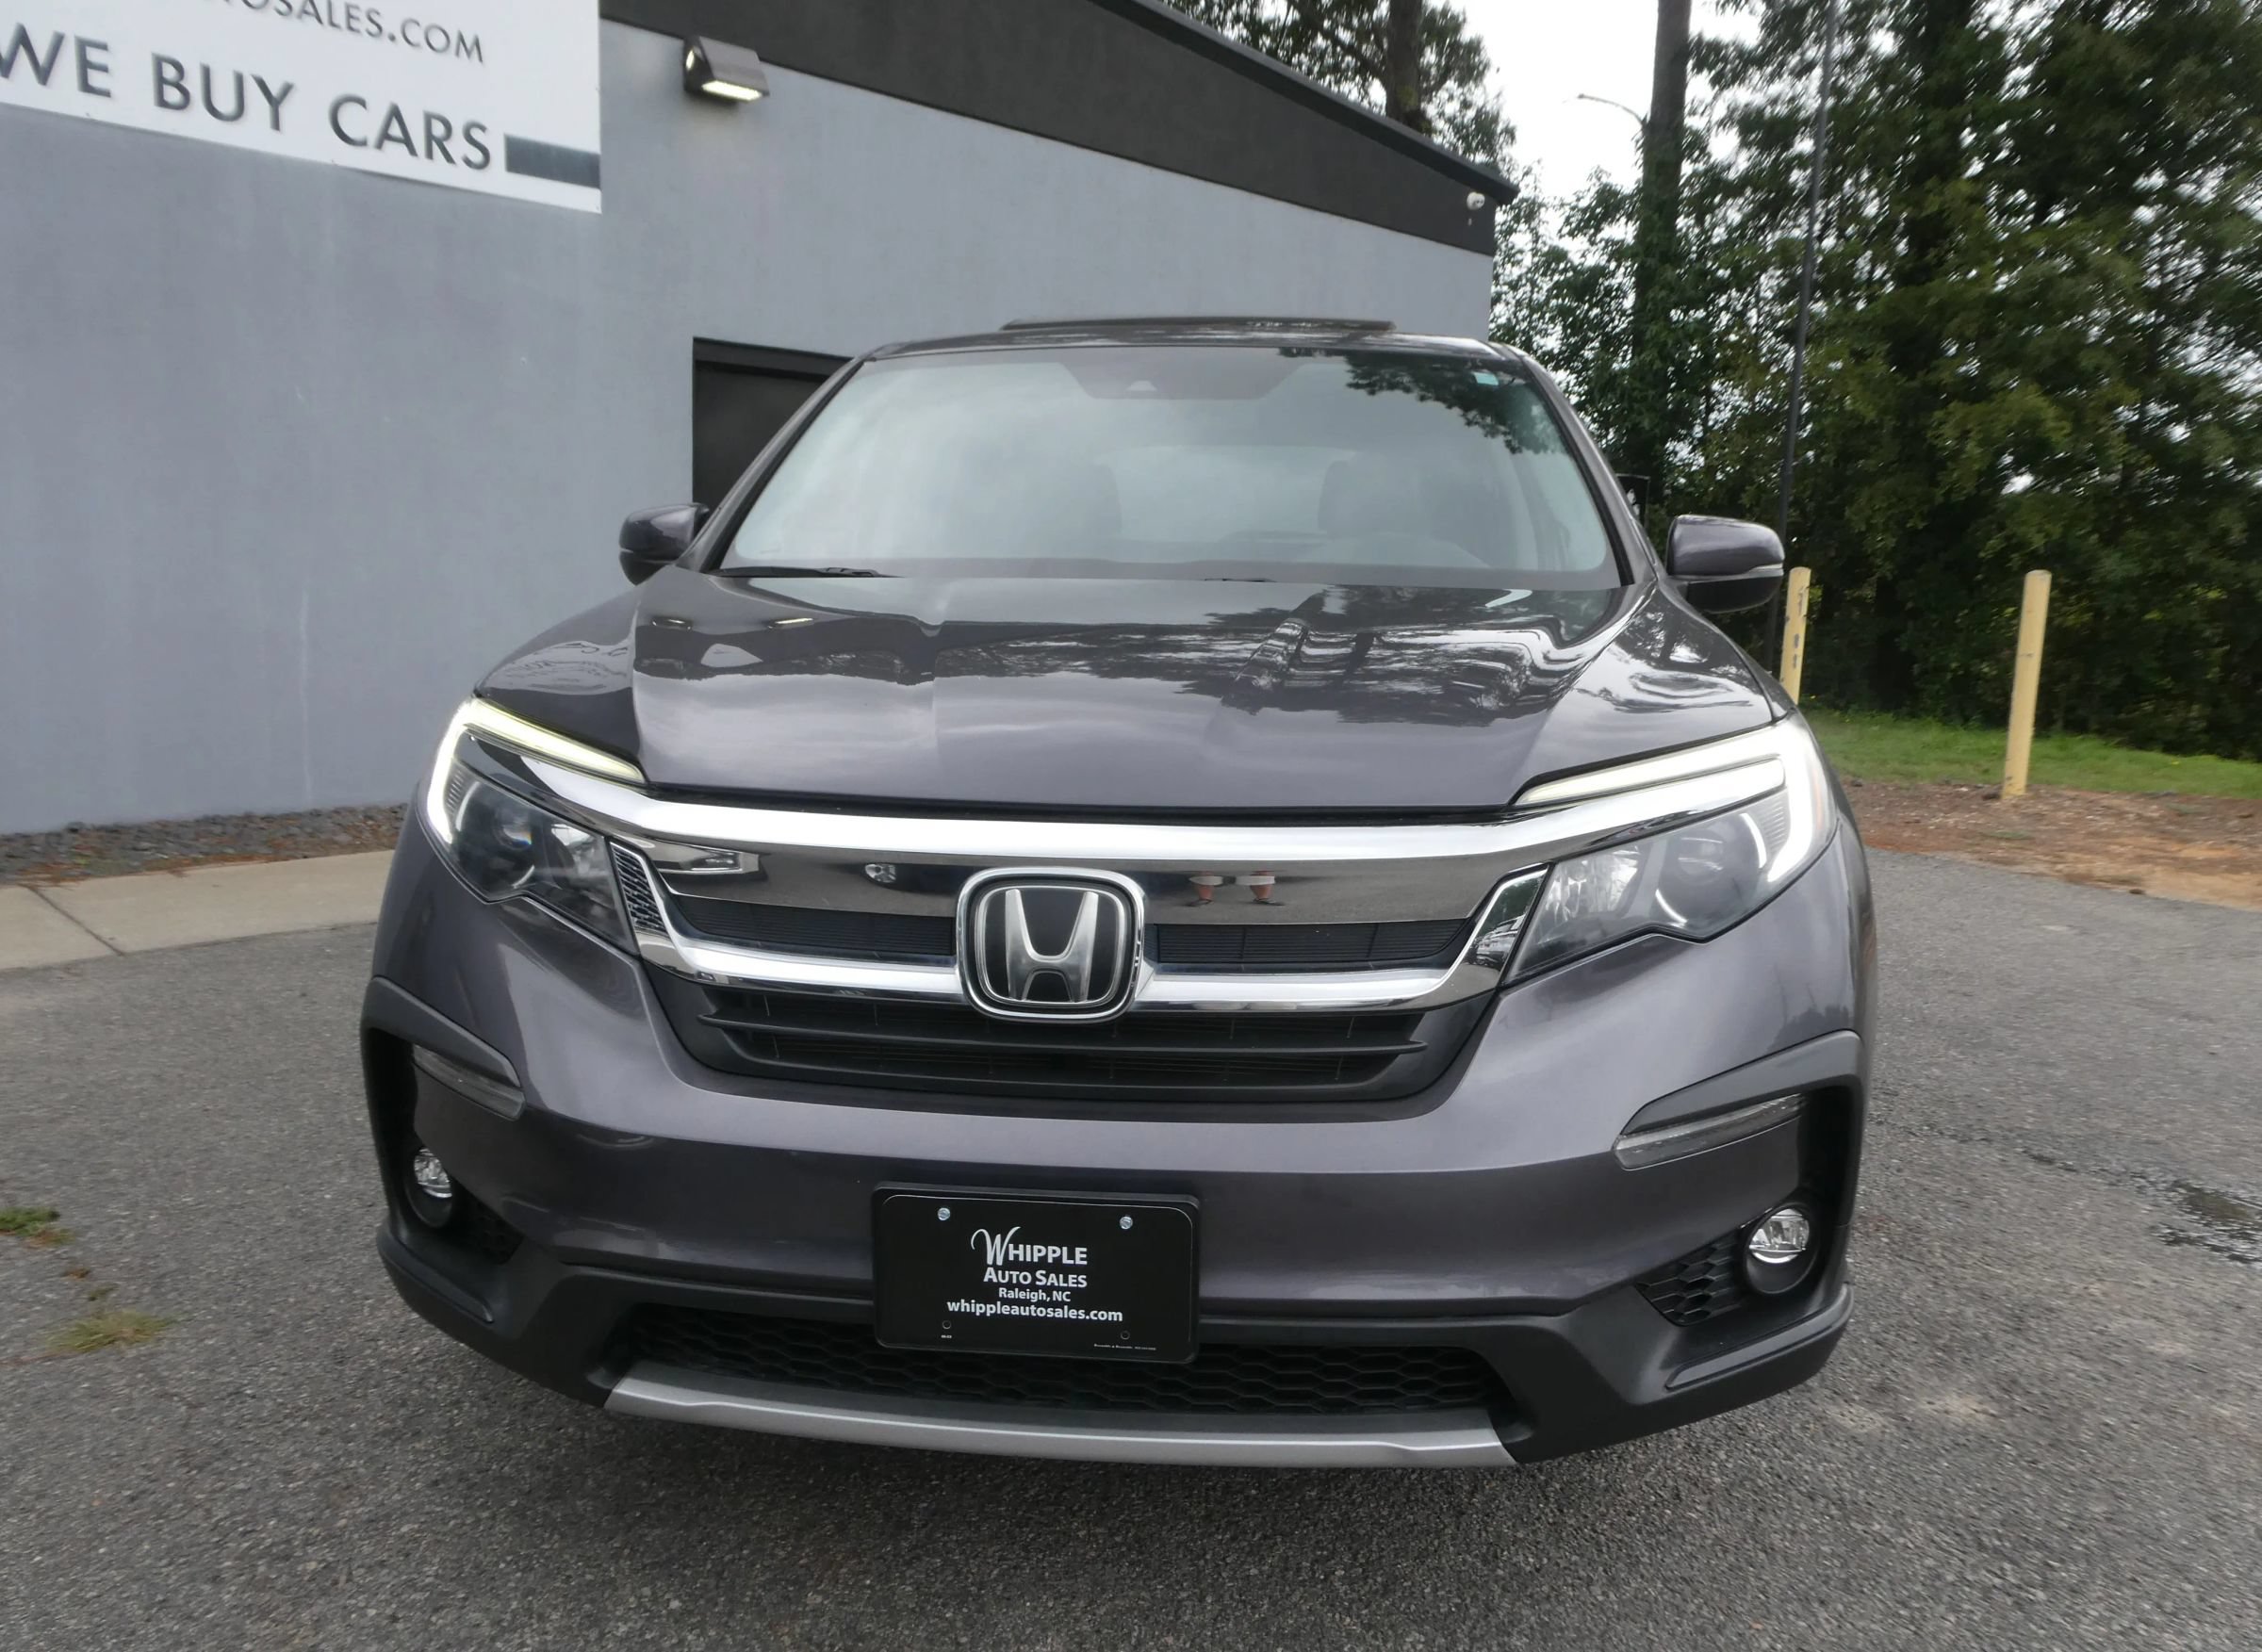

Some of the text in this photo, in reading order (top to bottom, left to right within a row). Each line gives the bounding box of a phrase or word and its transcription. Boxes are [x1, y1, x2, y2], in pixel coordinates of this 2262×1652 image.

[0, 23, 492, 171] WE BUY CARS
[971, 1226, 1088, 1267] WHIPPLE
[983, 1267, 1088, 1288] AUTO SALES
[998, 1287, 1072, 1302] Raleigh, NC
[947, 1299, 1123, 1322] whippleautosales.com
